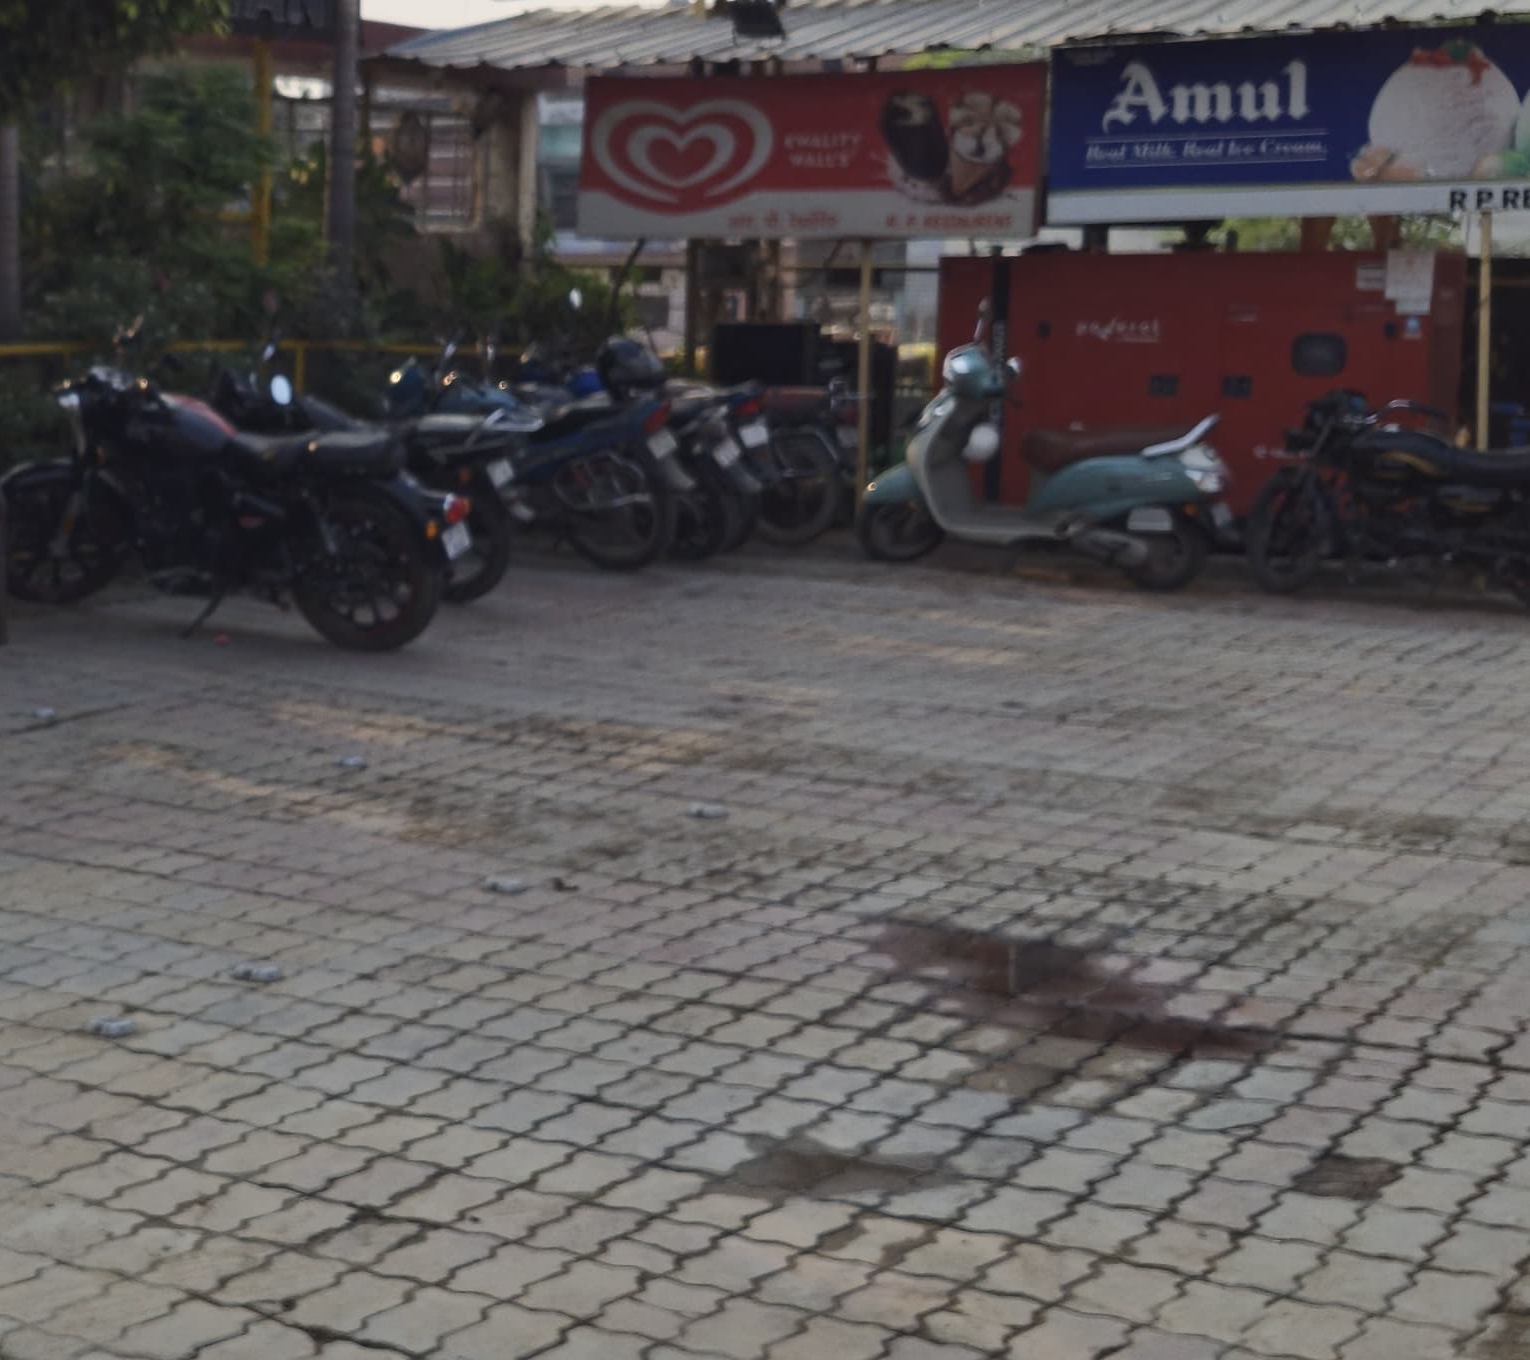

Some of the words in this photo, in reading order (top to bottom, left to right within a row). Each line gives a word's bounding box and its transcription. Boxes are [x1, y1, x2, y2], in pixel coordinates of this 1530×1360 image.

[1101, 59, 1310, 134] Amul
[1450, 191, 1467, 210] R
[1476, 190, 1493, 209] P
